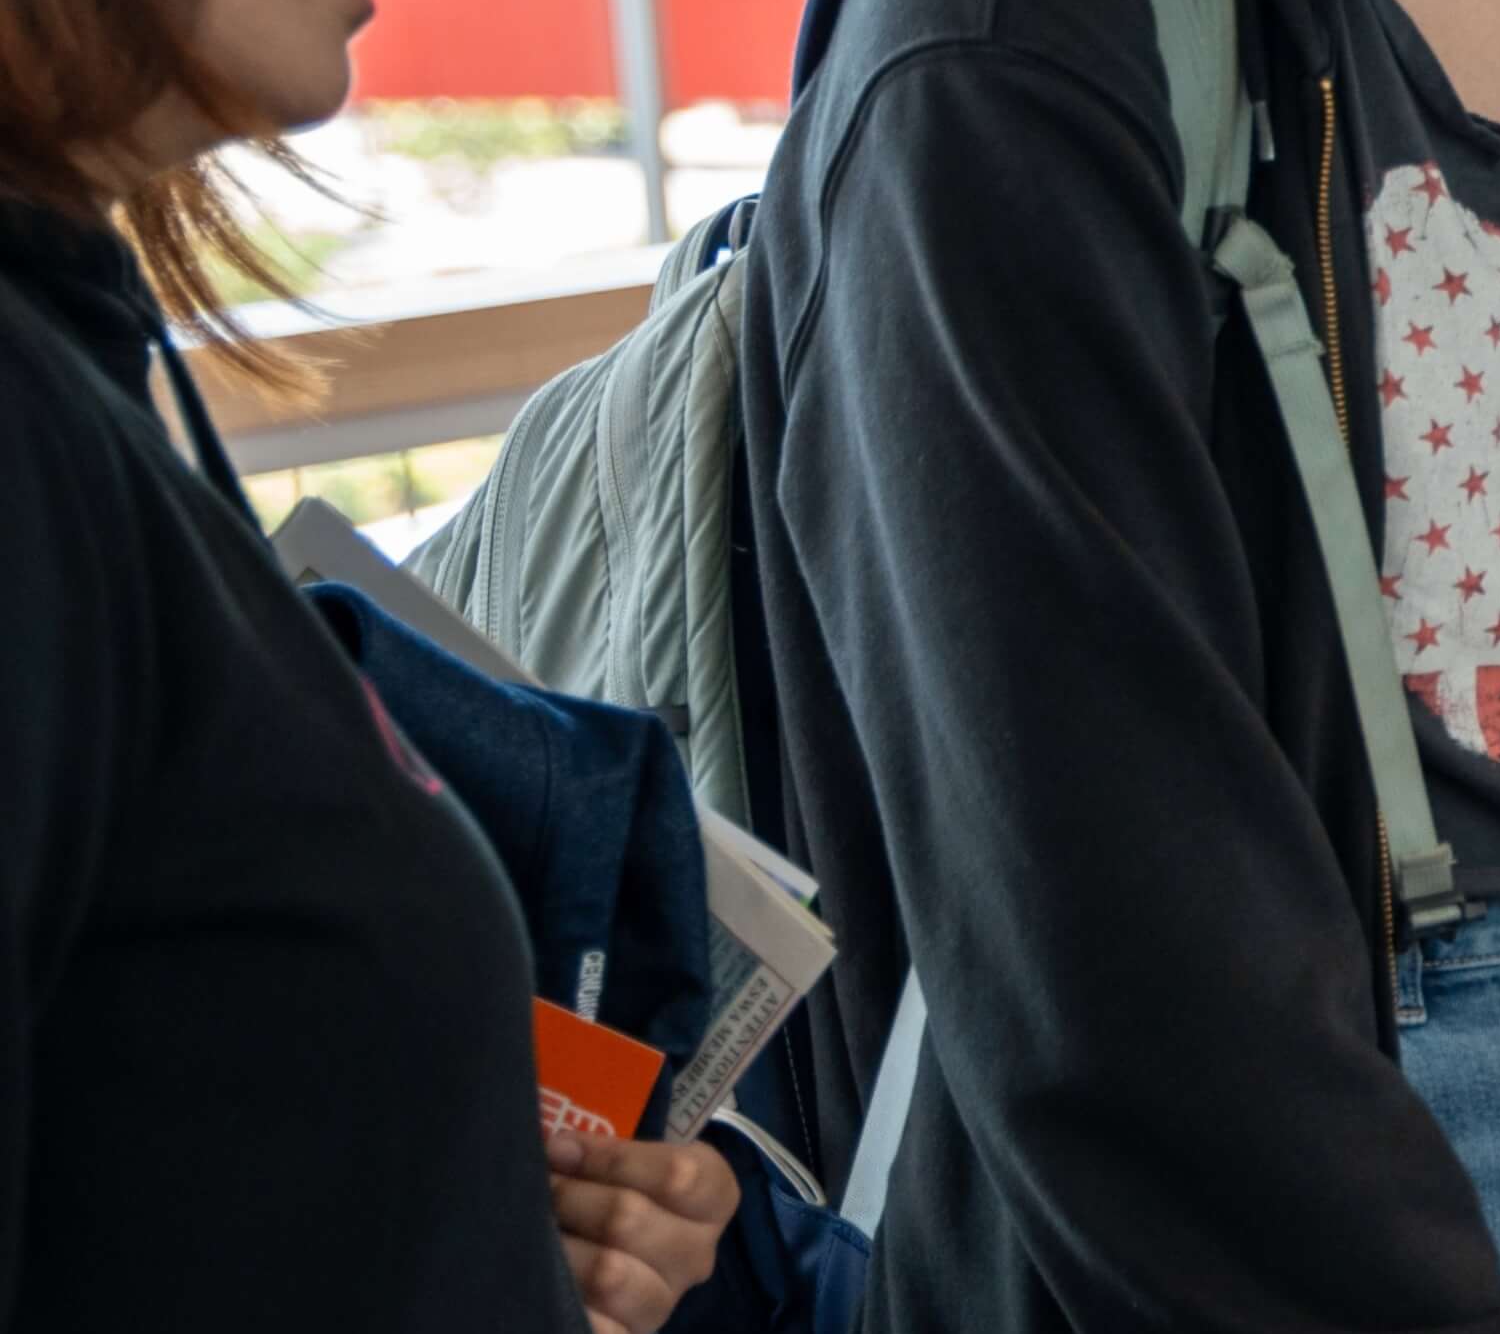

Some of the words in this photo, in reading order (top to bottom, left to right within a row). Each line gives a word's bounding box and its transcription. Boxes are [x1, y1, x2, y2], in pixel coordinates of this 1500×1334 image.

[728, 975, 769, 1024] ESWA
[711, 992, 779, 1089] ATTENTION
[681, 1086, 712, 1119] ALL
